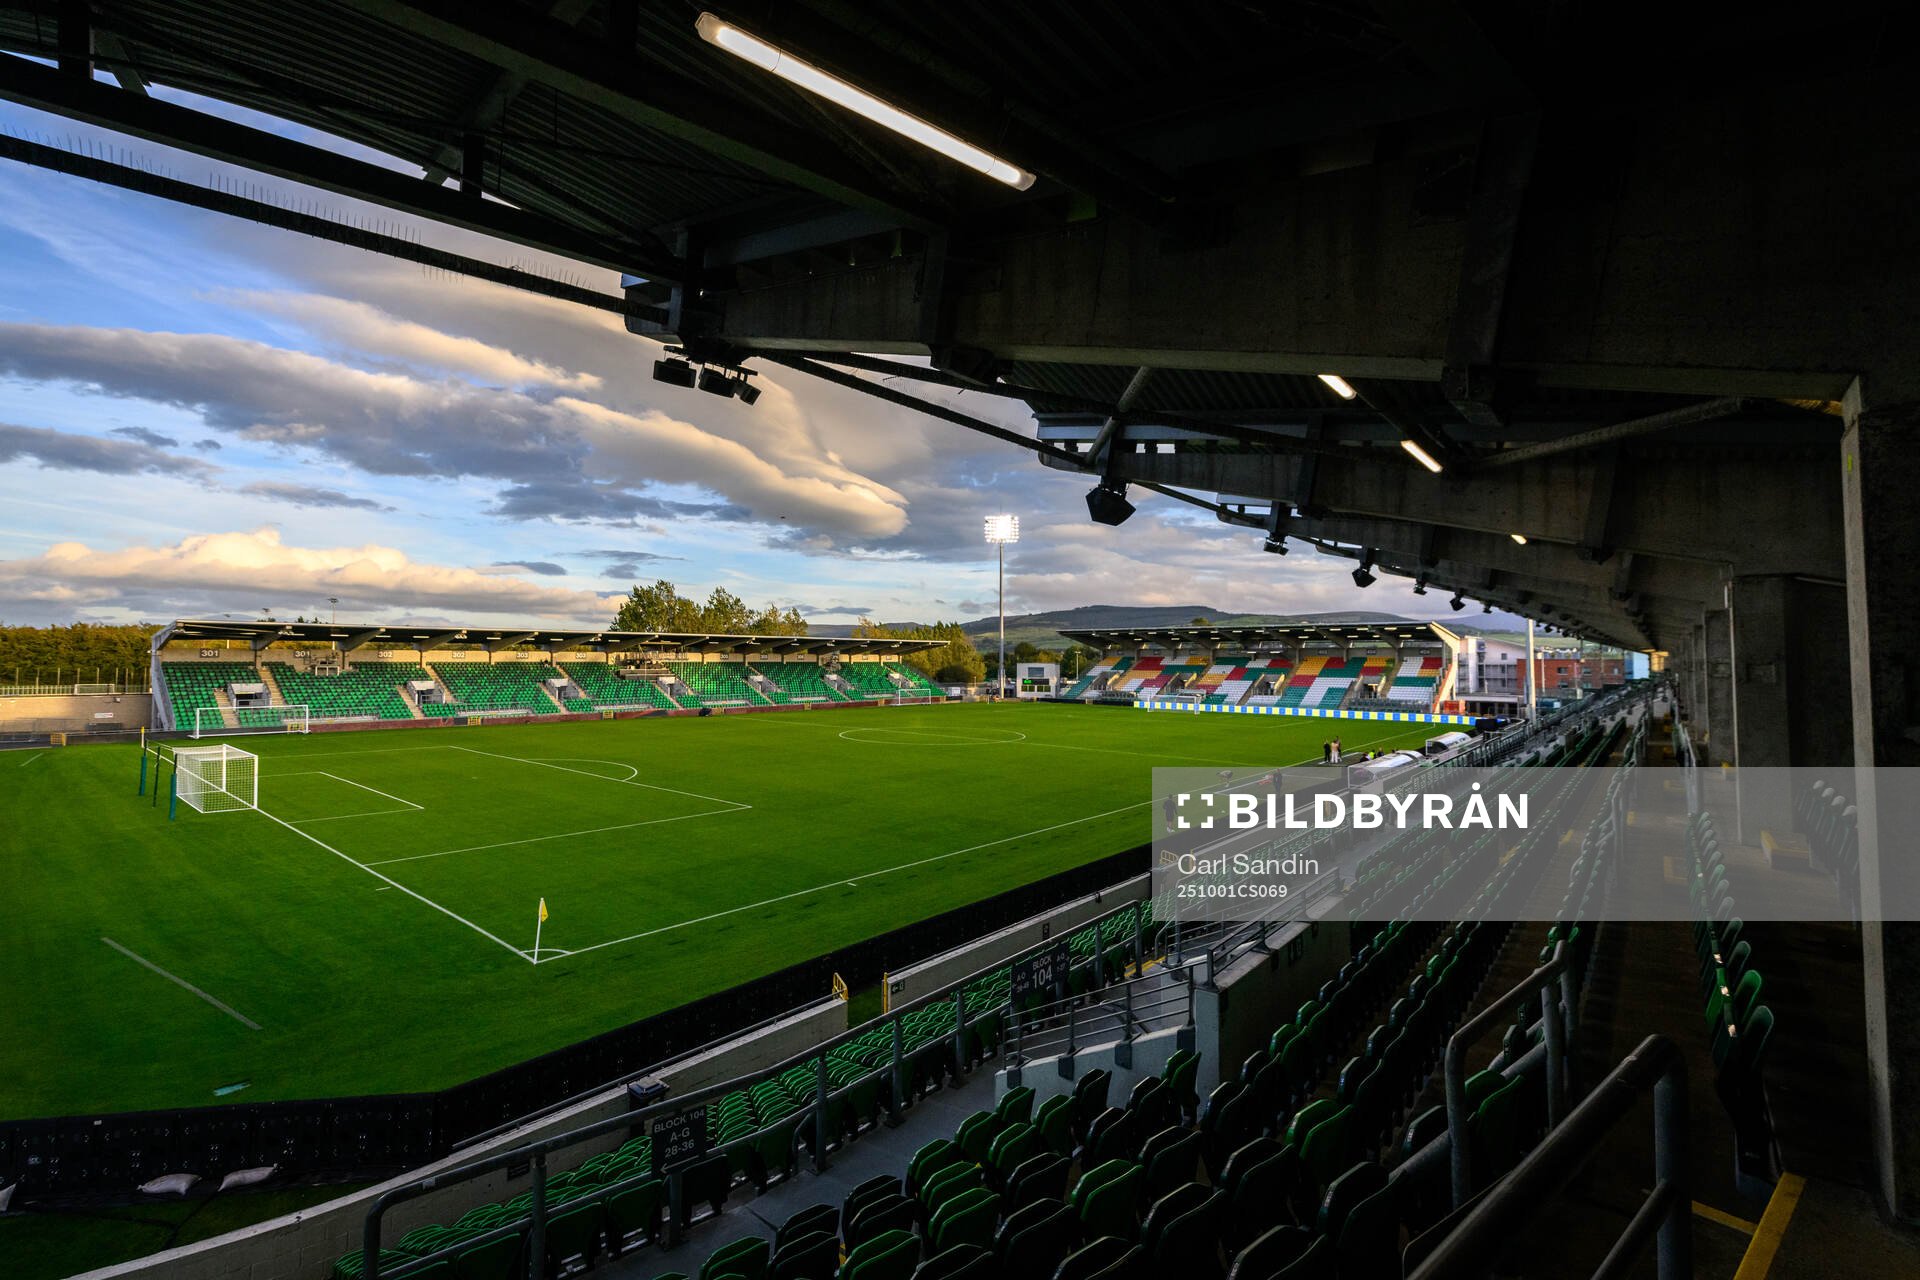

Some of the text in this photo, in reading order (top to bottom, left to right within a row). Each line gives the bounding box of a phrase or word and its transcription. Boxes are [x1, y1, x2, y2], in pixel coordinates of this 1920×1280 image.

[201, 649, 219, 657] 301
[1032, 955, 1052, 970] BLOCK
[1033, 965, 1052, 989] 104
[654, 1109, 705, 1133] BLOCK 104
[670, 1127, 690, 1142] A-G
[664, 1139, 695, 1158] 28-36
